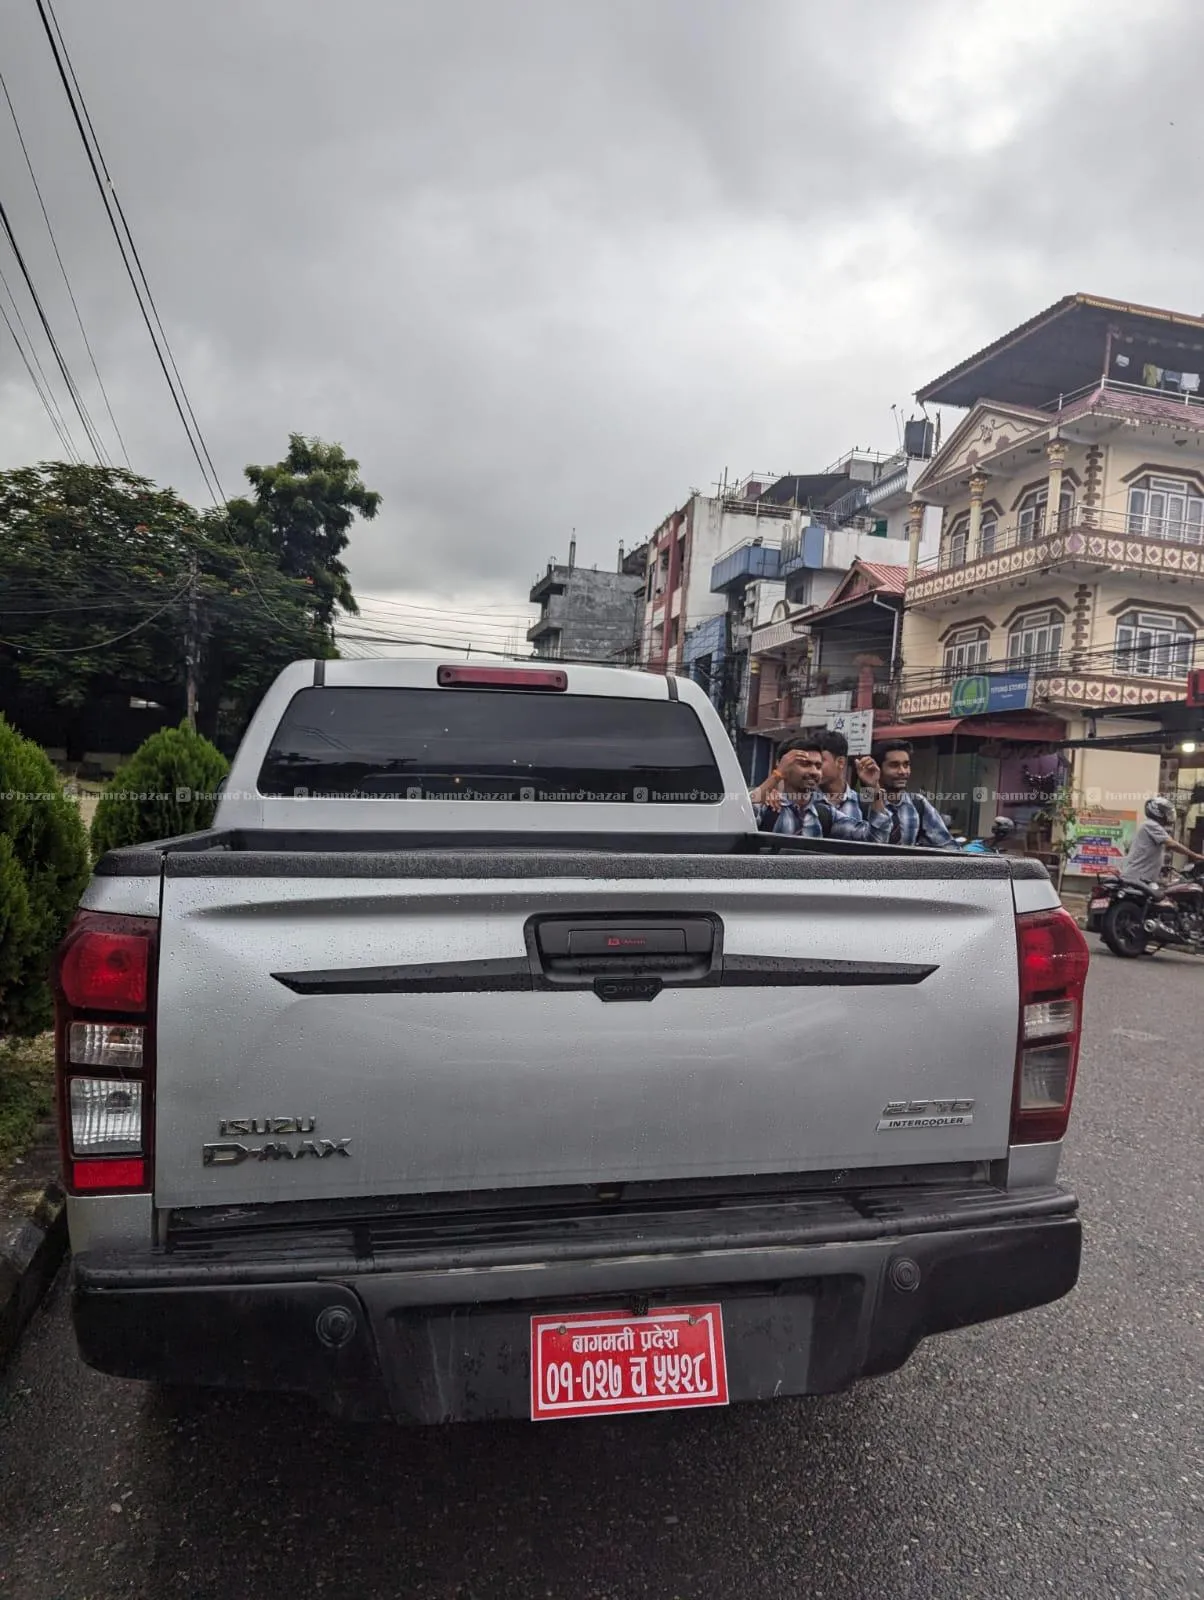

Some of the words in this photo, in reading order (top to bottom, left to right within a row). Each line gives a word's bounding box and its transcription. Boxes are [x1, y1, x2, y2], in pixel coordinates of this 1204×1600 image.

[220, 1116, 316, 1136] ISUZU
[889, 1117, 964, 1128] INTERCOOLER
[203, 1138, 352, 1167] D-MAX
[572, 1326, 635, 1353] बागमती
[640, 1324, 679, 1352] प्रदेश
[547, 1358, 623, 1402] ०१-०२७
[629, 1356, 648, 1396] च
[653, 1352, 708, 1394] ५५२८
